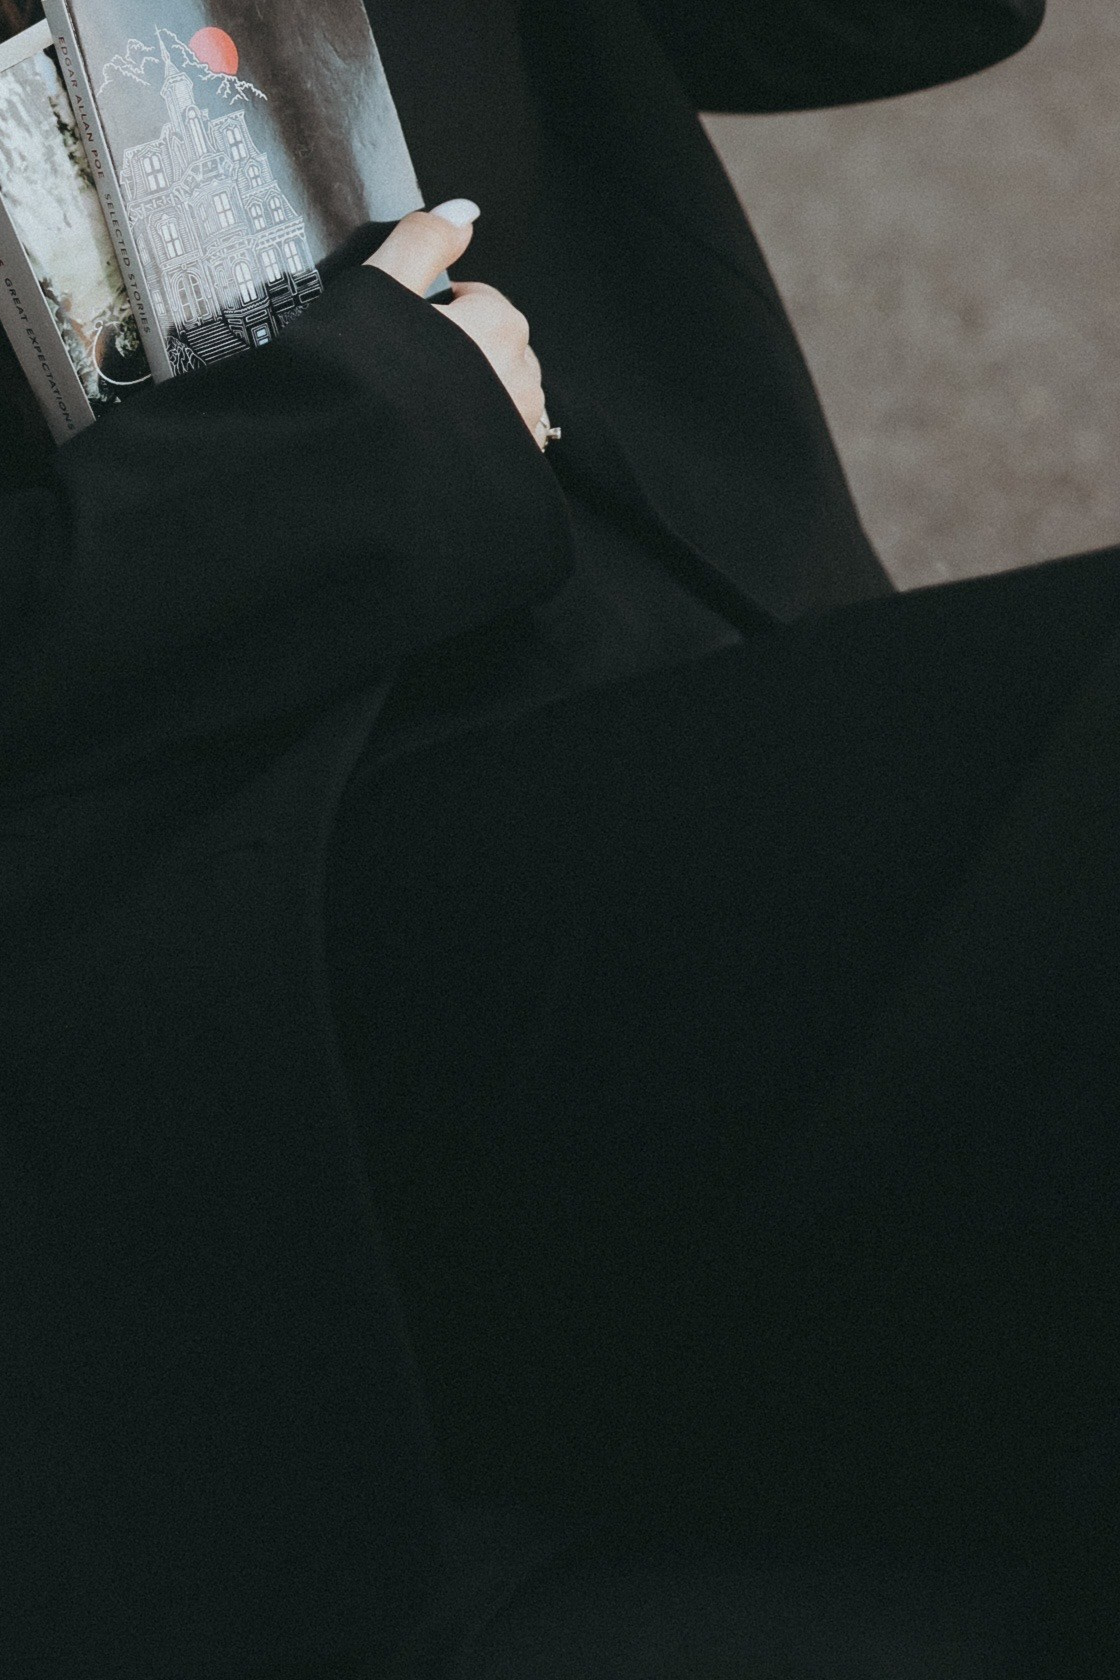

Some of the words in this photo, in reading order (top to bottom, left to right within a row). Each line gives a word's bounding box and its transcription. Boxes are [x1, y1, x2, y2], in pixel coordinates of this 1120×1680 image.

[59, 36, 78, 88] EDGAR
[75, 94, 94, 142] ALLAN
[91, 150, 104, 179] POE
[105, 193, 130, 267] SELECTED
[128, 273, 150, 334] STORIES
[4, 277, 28, 323] GREAT
[26, 327, 75, 431] EXPECTATIONS
